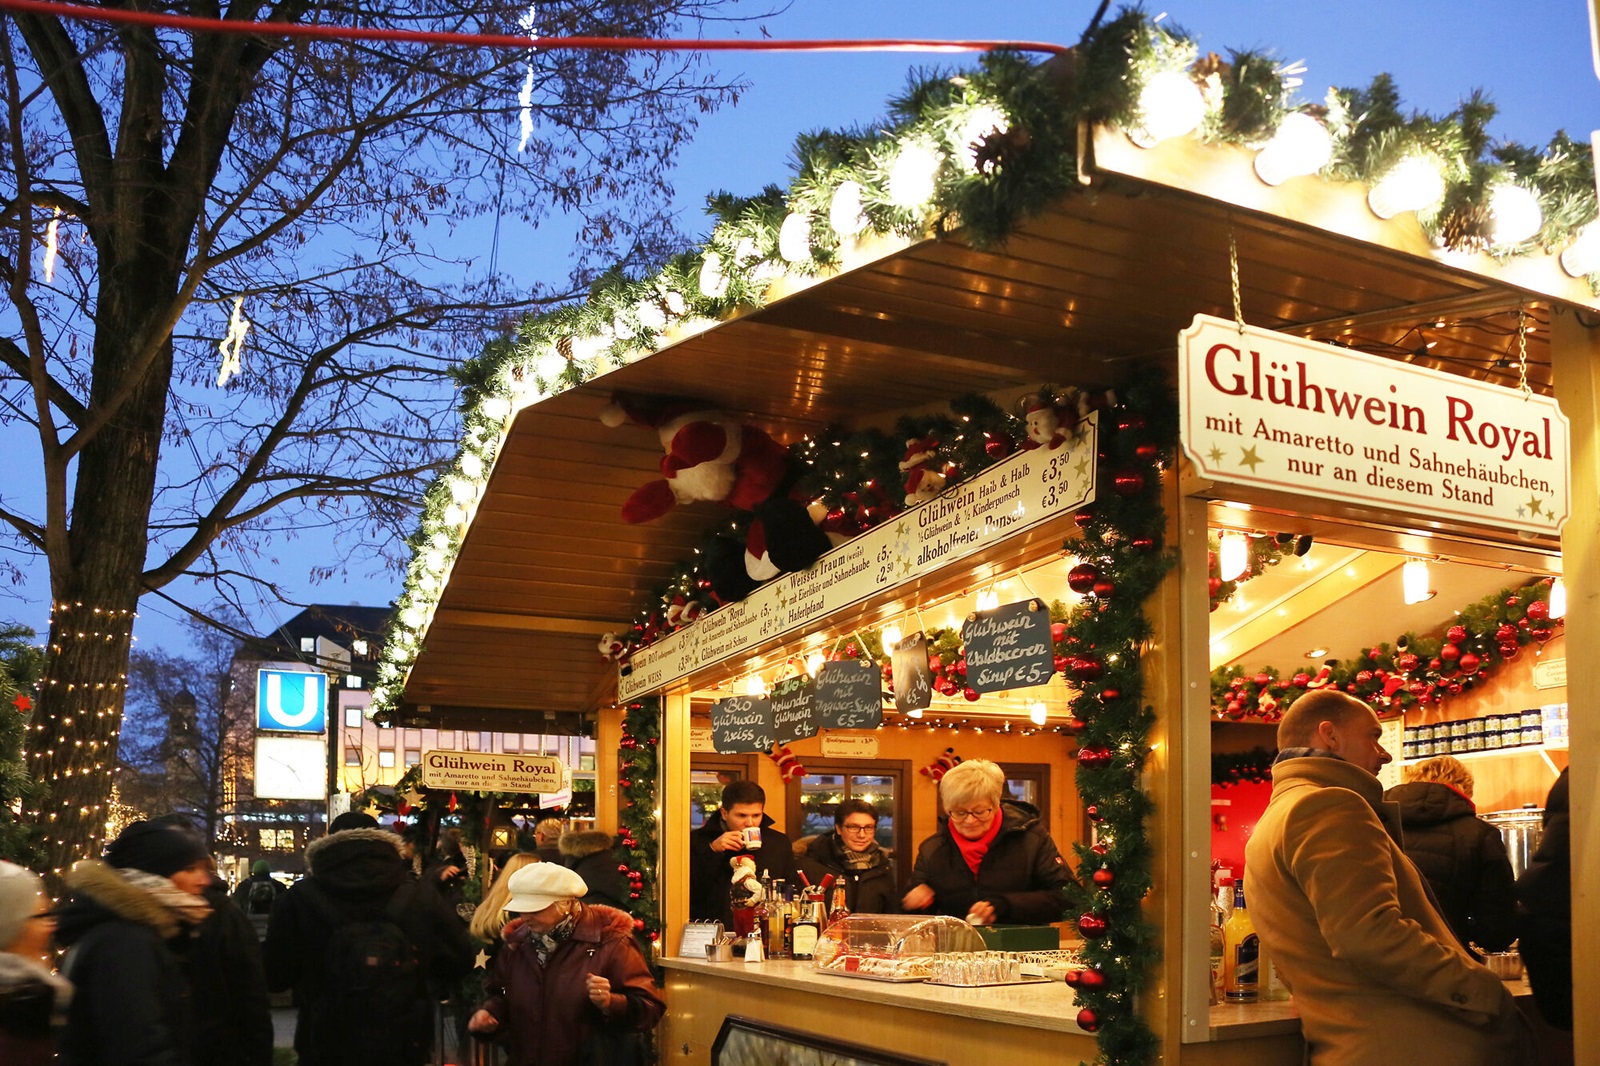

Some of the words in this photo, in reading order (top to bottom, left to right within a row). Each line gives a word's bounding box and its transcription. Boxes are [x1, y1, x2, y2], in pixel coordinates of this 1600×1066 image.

[1205, 343, 1427, 435] Glühwein
[1446, 396, 1553, 462] Royal
[1205, 412, 1243, 436] mit
[1253, 418, 1354, 457] Amaretto
[1363, 445, 1400, 465] und
[1409, 448, 1555, 496] Sahnehäubchen,
[1287, 457, 1324, 477] nur
[1333, 466, 1357, 483] an
[1366, 466, 1434, 497] diesem
[1442, 479, 1494, 508] Stand
[918, 487, 975, 528] Glühwein
[1000, 474, 1008, 487] &
[1010, 463, 1030, 483] Halb
[953, 514, 961, 526] &
[972, 484, 1020, 517] Kinderpunsch
[917, 526, 980, 566] alkoholfreier
[984, 500, 1026, 536] Punsch
[788, 593, 798, 605] mit
[822, 577, 834, 590] und
[834, 558, 871, 584] Sahnehaube
[789, 568, 819, 590] Weisser
[819, 555, 846, 576] Traum
[788, 595, 825, 624] Haferlpfand
[702, 612, 727, 634] Glühwein
[965, 612, 1036, 646] Glühwein
[992, 630, 1020, 647] mit
[701, 641, 725, 661] Glühwein
[966, 642, 1048, 667] Waldbeeren
[816, 668, 873, 690] Glühwein
[977, 666, 1014, 686] Sirup
[780, 680, 800, 696] Bio
[833, 684, 854, 697] mit
[266, 674, 318, 727] U
[723, 697, 753, 713] Bio
[771, 690, 814, 713] Holunder
[712, 712, 765, 732] Glühwein
[774, 706, 812, 729] Glühwein
[723, 727, 754, 743] weiss
[429, 755, 506, 772] Glühwein
[513, 759, 556, 776] Royal
[444, 772, 479, 780] Amaretto
[510, 781, 532, 789] Stand
